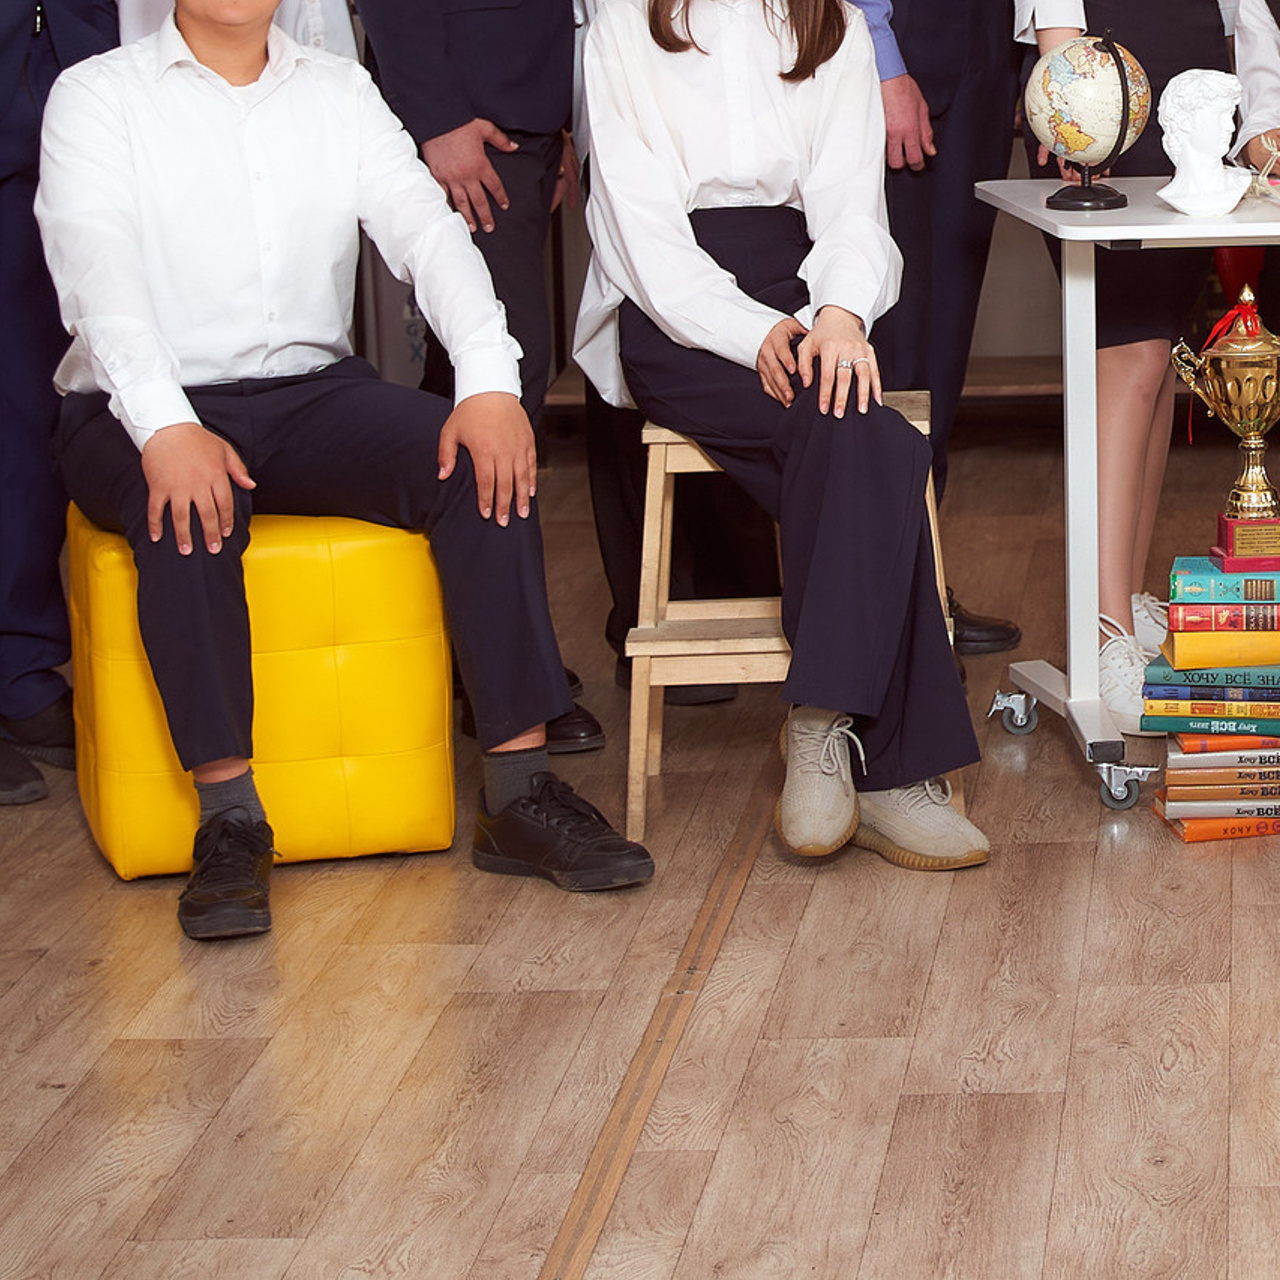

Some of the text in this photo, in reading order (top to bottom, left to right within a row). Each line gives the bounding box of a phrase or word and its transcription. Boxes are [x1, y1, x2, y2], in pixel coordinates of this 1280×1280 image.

[1182, 672, 1219, 684] ХОЧУ
[1225, 672, 1252, 685] ВСЁ
[1210, 721, 1236, 734] ВСЁ
[1237, 755, 1257, 764] Хочу
[1237, 771, 1257, 780] Хочу
[1239, 788, 1259, 797] Хочу
[1234, 807, 1255, 816] Хочу
